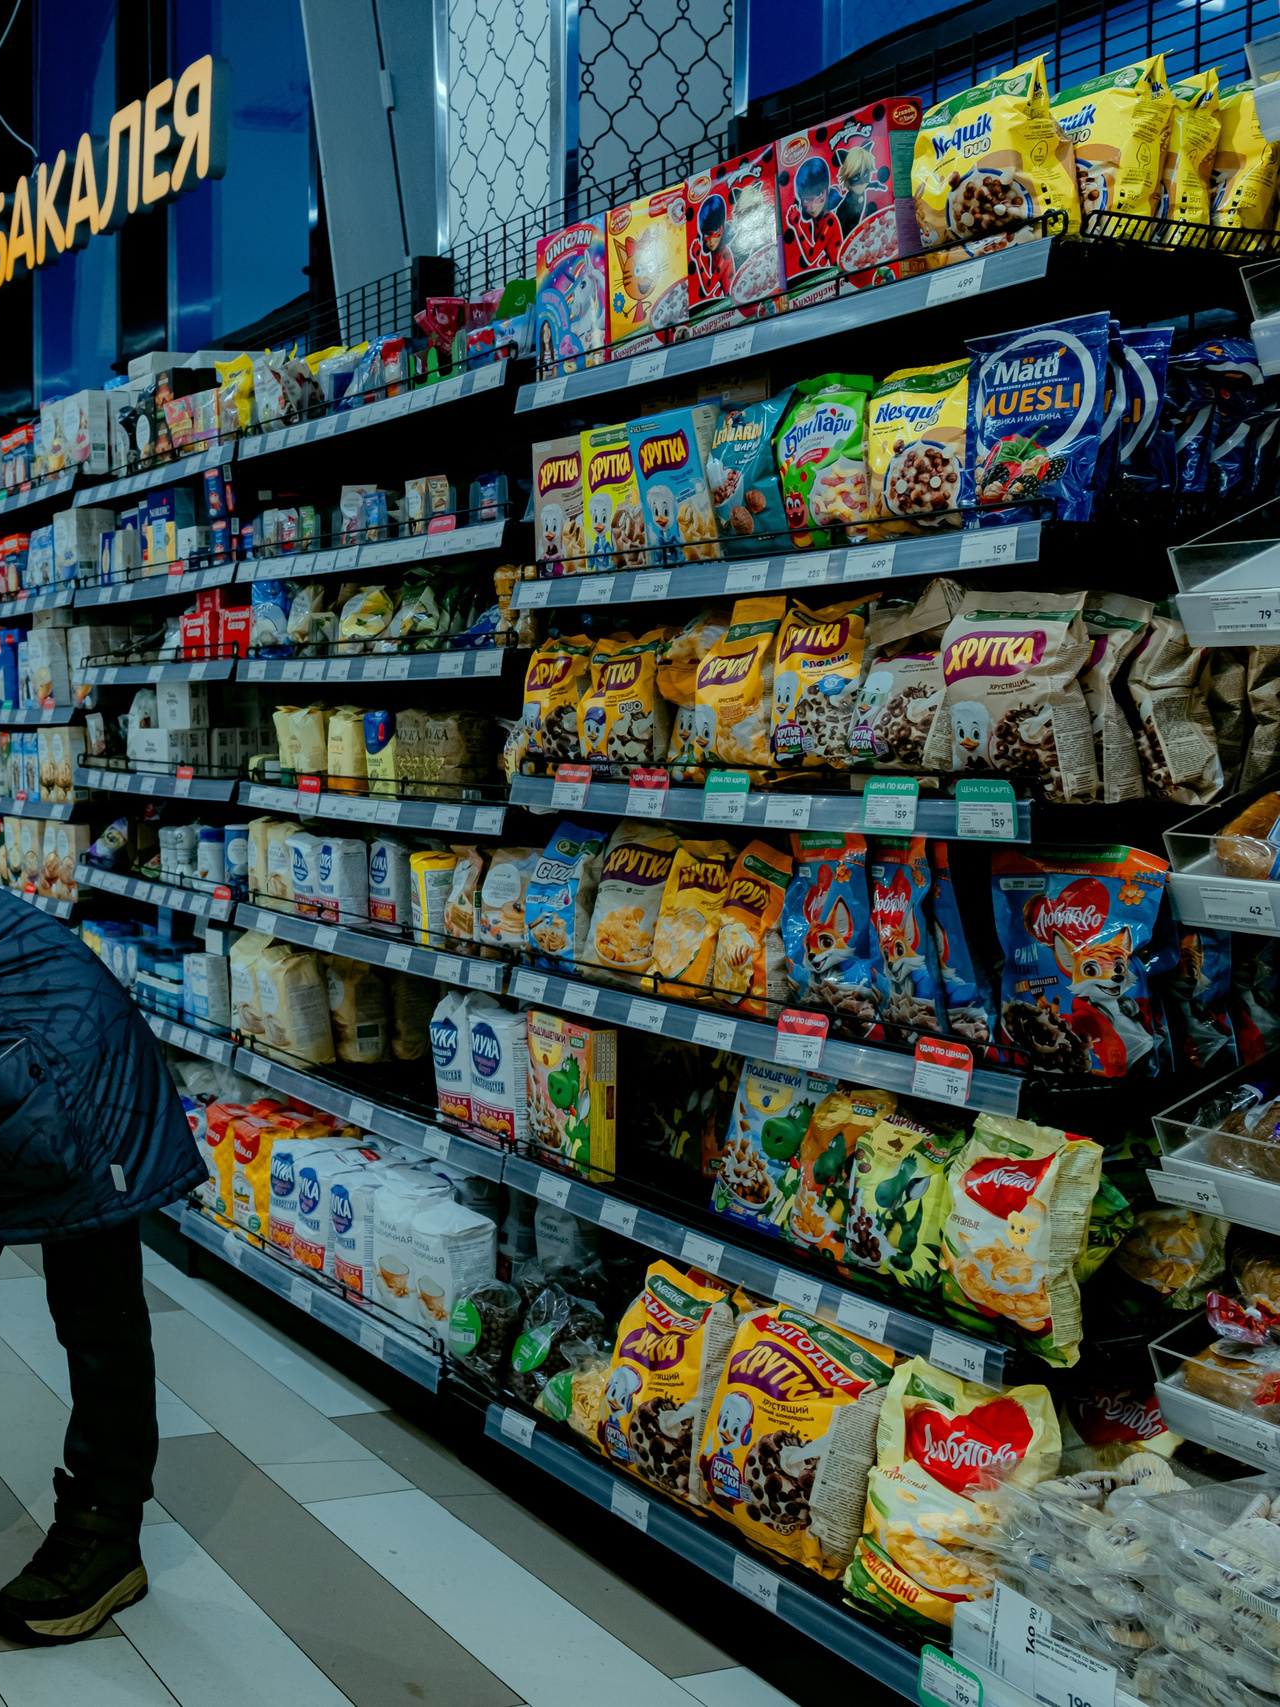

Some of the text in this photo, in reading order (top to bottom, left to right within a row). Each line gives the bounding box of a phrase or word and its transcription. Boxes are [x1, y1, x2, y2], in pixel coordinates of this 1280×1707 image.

[963, 137, 991, 159] DUO
[546, 229, 593, 263] UNICORN
[957, 277, 974, 289] 499
[692, 310, 736, 336] Кукурузные
[613, 334, 655, 360] Кукурузные
[734, 342, 746, 352] 249
[649, 363, 661, 373] 249
[994, 347, 1067, 385] Mätti
[982, 382, 1081, 418] MUESLI
[1025, 411, 1061, 422] МАЛИНА
[784, 419, 813, 459] Бон
[813, 408, 854, 437] Пари
[640, 436, 687, 473] ХРУТКА
[590, 451, 631, 486] ХРУТКА
[540, 459, 579, 491] ХРУТКА
[149, 505, 170, 518] NORDIC
[992, 543, 1008, 555] 159
[871, 559, 887, 569] 499
[751, 573, 761, 583] 119
[808, 569, 821, 579] 229
[652, 583, 664, 593] 229
[535, 590, 545, 599] 229
[1258, 610, 1271, 619] 79
[781, 623, 841, 657] ХРУТКА
[946, 632, 1036, 676] ХРУТКА
[801, 652, 850, 669] АЛФАВИТ
[989, 678, 1030, 691] ХРУСТЯЩИЕ
[618, 700, 643, 714] DUO
[776, 727, 802, 740] ХРУТЫЕ
[776, 736, 801, 748] УРОКИ
[709, 776, 724, 785] ЦЕНА
[732, 777, 747, 786] КАРТЕ
[870, 781, 886, 791] ЦЕНА
[896, 782, 915, 792] КАРТЕ
[960, 785, 1011, 795] ЦЕНА ПО КАРТЕ
[648, 801, 658, 811] 149
[728, 805, 739, 814] 159
[792, 808, 803, 817] 147
[894, 809, 907, 819] 159
[991, 818, 1005, 829] 159
[603, 848, 672, 879] ХРУТКА
[1249, 905, 1262, 916] 42
[1035, 901, 1102, 933] Любятово
[582, 1000, 591, 1008] 199
[648, 1016, 658, 1025] 199
[782, 1014, 796, 1024] УДАР
[806, 1018, 826, 1028] ЦЕНАМ!
[528, 1023, 567, 1045] ПОДУШЕЧКИ
[717, 1032, 727, 1041] 199
[471, 1034, 500, 1061] МУКА
[570, 1038, 585, 1049] KIDS
[802, 1050, 813, 1060] 119
[919, 1044, 935, 1055] УДАР
[946, 1048, 970, 1061] ЦЕНАМ!
[745, 1064, 803, 1089] ПОДУШЕЧКИ
[808, 1081, 828, 1093] KIDS
[946, 1085, 959, 1096] 119
[853, 1106, 875, 1118] KIDS
[924, 1149, 945, 1165] KIDS
[557, 1190, 564, 1198] 99
[1197, 1191, 1210, 1202] 59
[622, 1217, 630, 1225] 99
[707, 1254, 715, 1263] 99
[652, 1281, 685, 1308] Nestlé
[803, 1294, 812, 1304] 99
[868, 1319, 878, 1330] 99
[766, 1320, 856, 1388] ВЫГОДНО
[963, 1358, 976, 1370] 116
[761, 1398, 810, 1415] ХРУСТЯЩИЙ
[767, 1416, 792, 1428] завтрак
[775, 1411, 816, 1424] шоколадный
[923, 1424, 1018, 1471] Любятово
[1256, 1441, 1269, 1452] 62
[714, 1458, 741, 1478] ХРУТЫЕ
[714, 1468, 741, 1490] УРОКИ
[866, 1549, 920, 1604] ВЫГОДНО
[758, 1585, 773, 1599] 369
[1030, 1607, 1038, 1620] 90
[954, 1690, 970, 1706] 199
